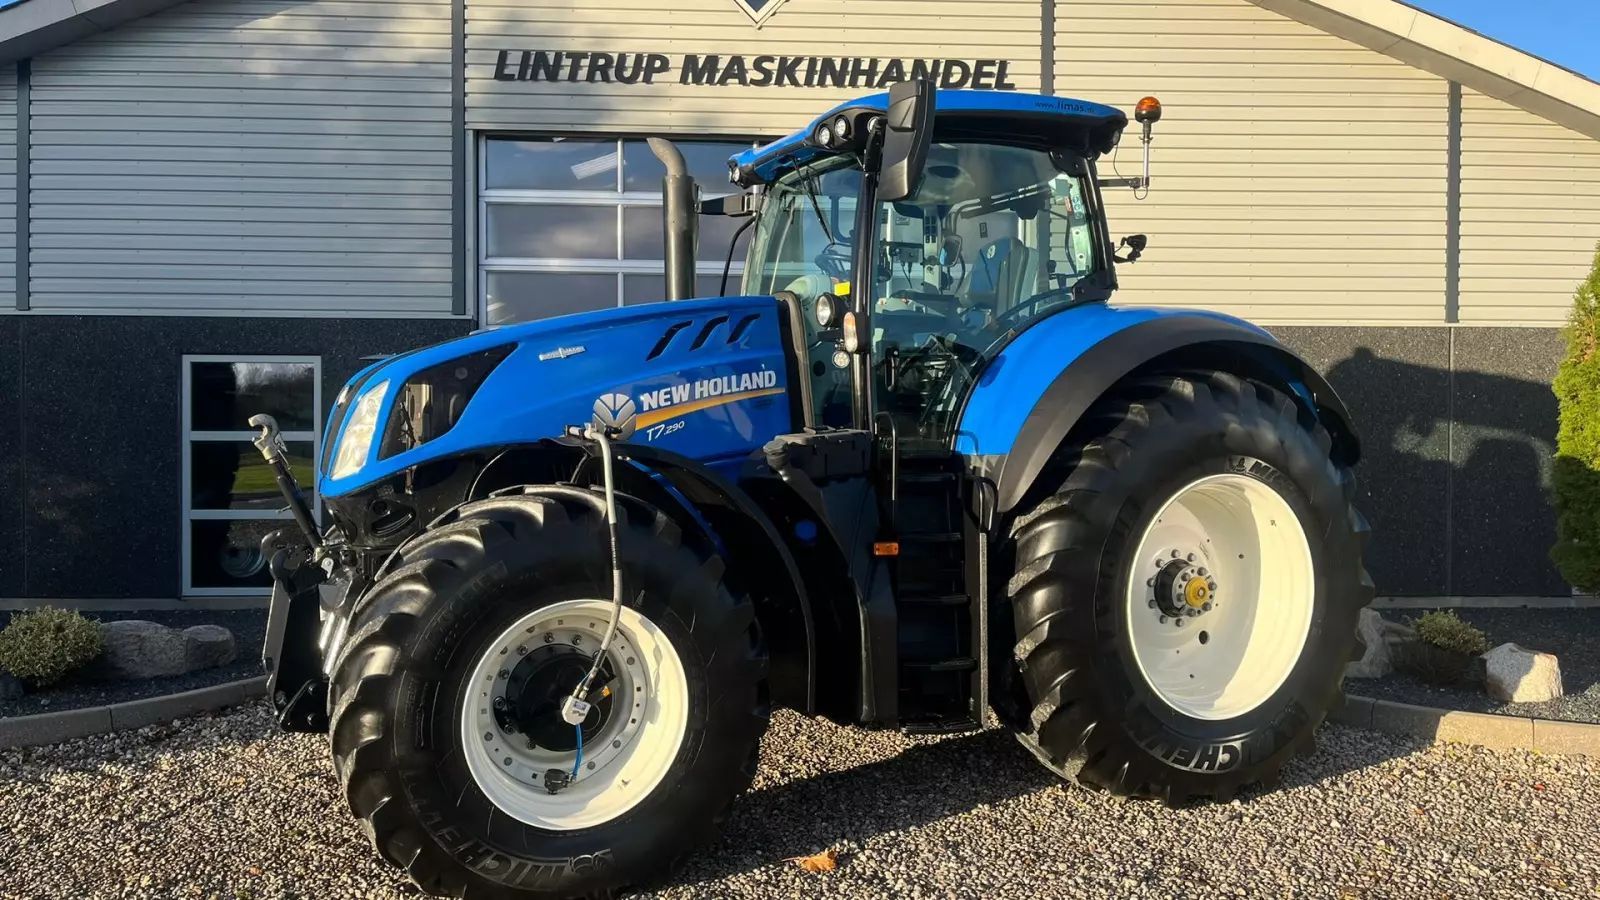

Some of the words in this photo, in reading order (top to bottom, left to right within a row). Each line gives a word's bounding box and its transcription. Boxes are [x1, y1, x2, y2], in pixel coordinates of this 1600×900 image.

[494, 50, 670, 84] LINTRUP
[679, 53, 1016, 90] MASKINHANDEL
[641, 383, 690, 411] NEW
[695, 370, 777, 399] HOLLAND
[646, 420, 685, 442] T7.290
